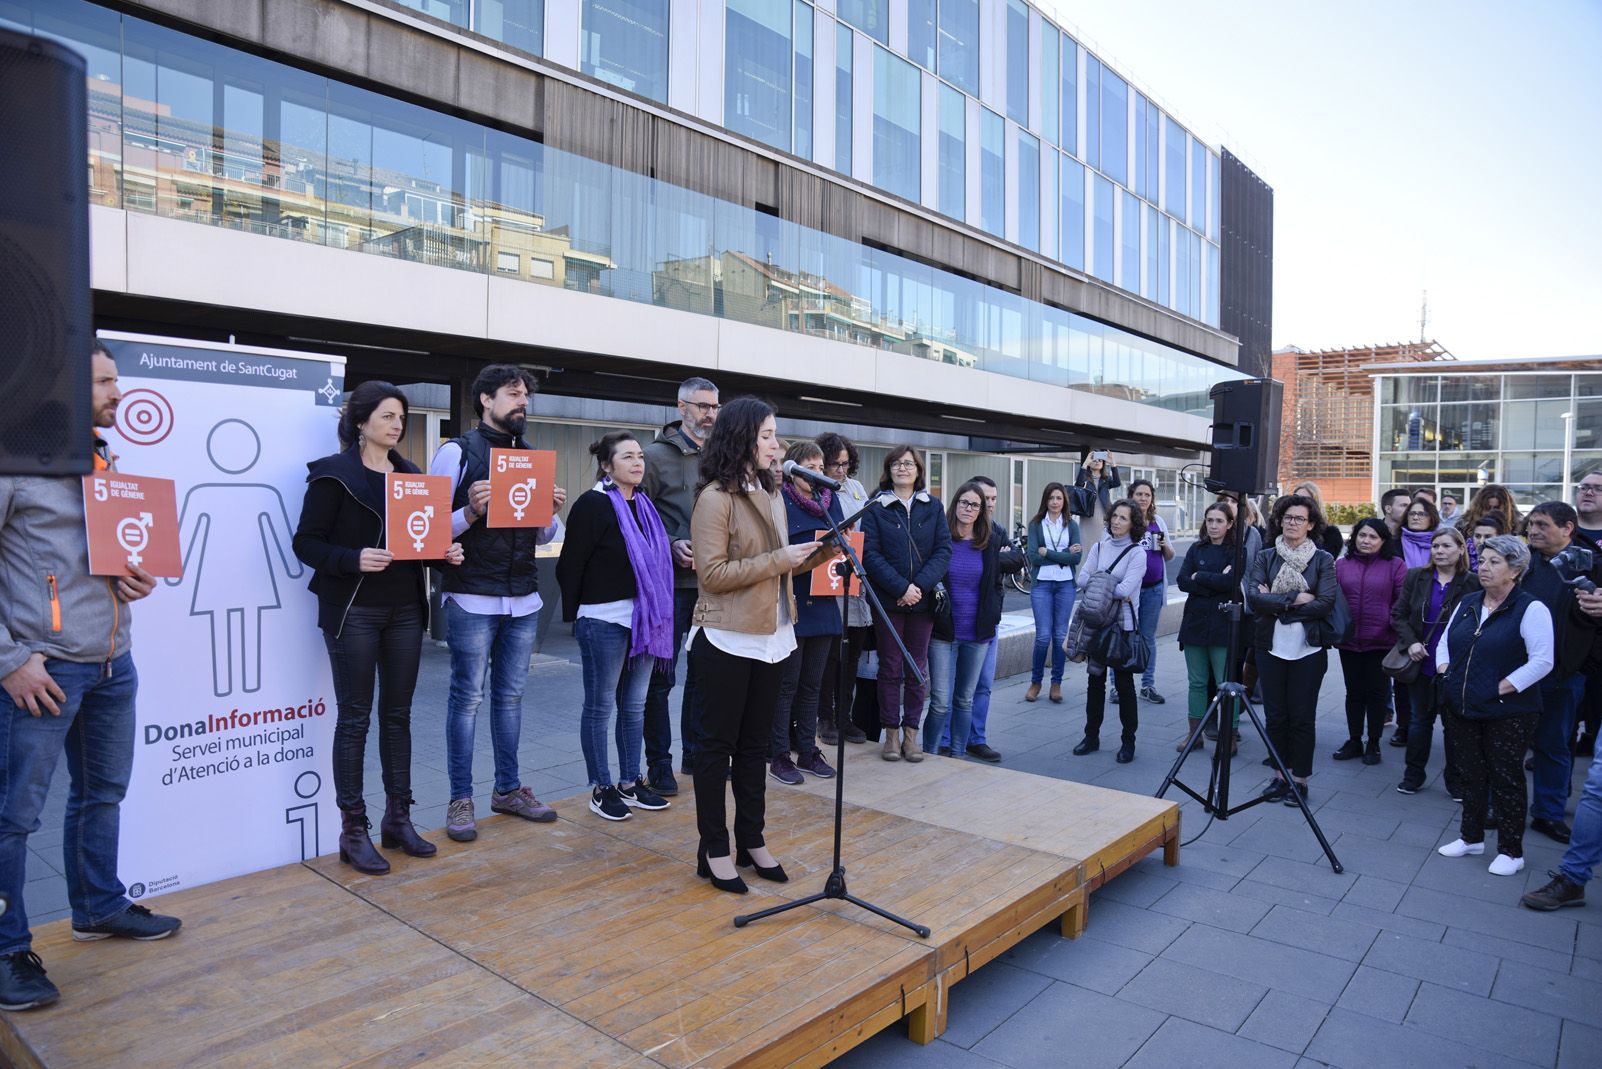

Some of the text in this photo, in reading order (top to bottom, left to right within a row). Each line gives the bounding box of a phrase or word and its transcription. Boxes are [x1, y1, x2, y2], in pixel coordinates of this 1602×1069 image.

[139, 352, 298, 381] Ajuntament de SantCugat
[497, 455, 507, 473] 5
[93, 478, 108, 501] 5
[109, 480, 138, 490] IGUALTAT
[110, 489, 120, 497] DE
[393, 480, 404, 500] 5
[144, 697, 326, 745] DonaInformació
[172, 723, 304, 762] Servei municipal
[161, 746, 314, 786] d'Atenció a la dona
[148, 881, 180, 894] Barcelona
